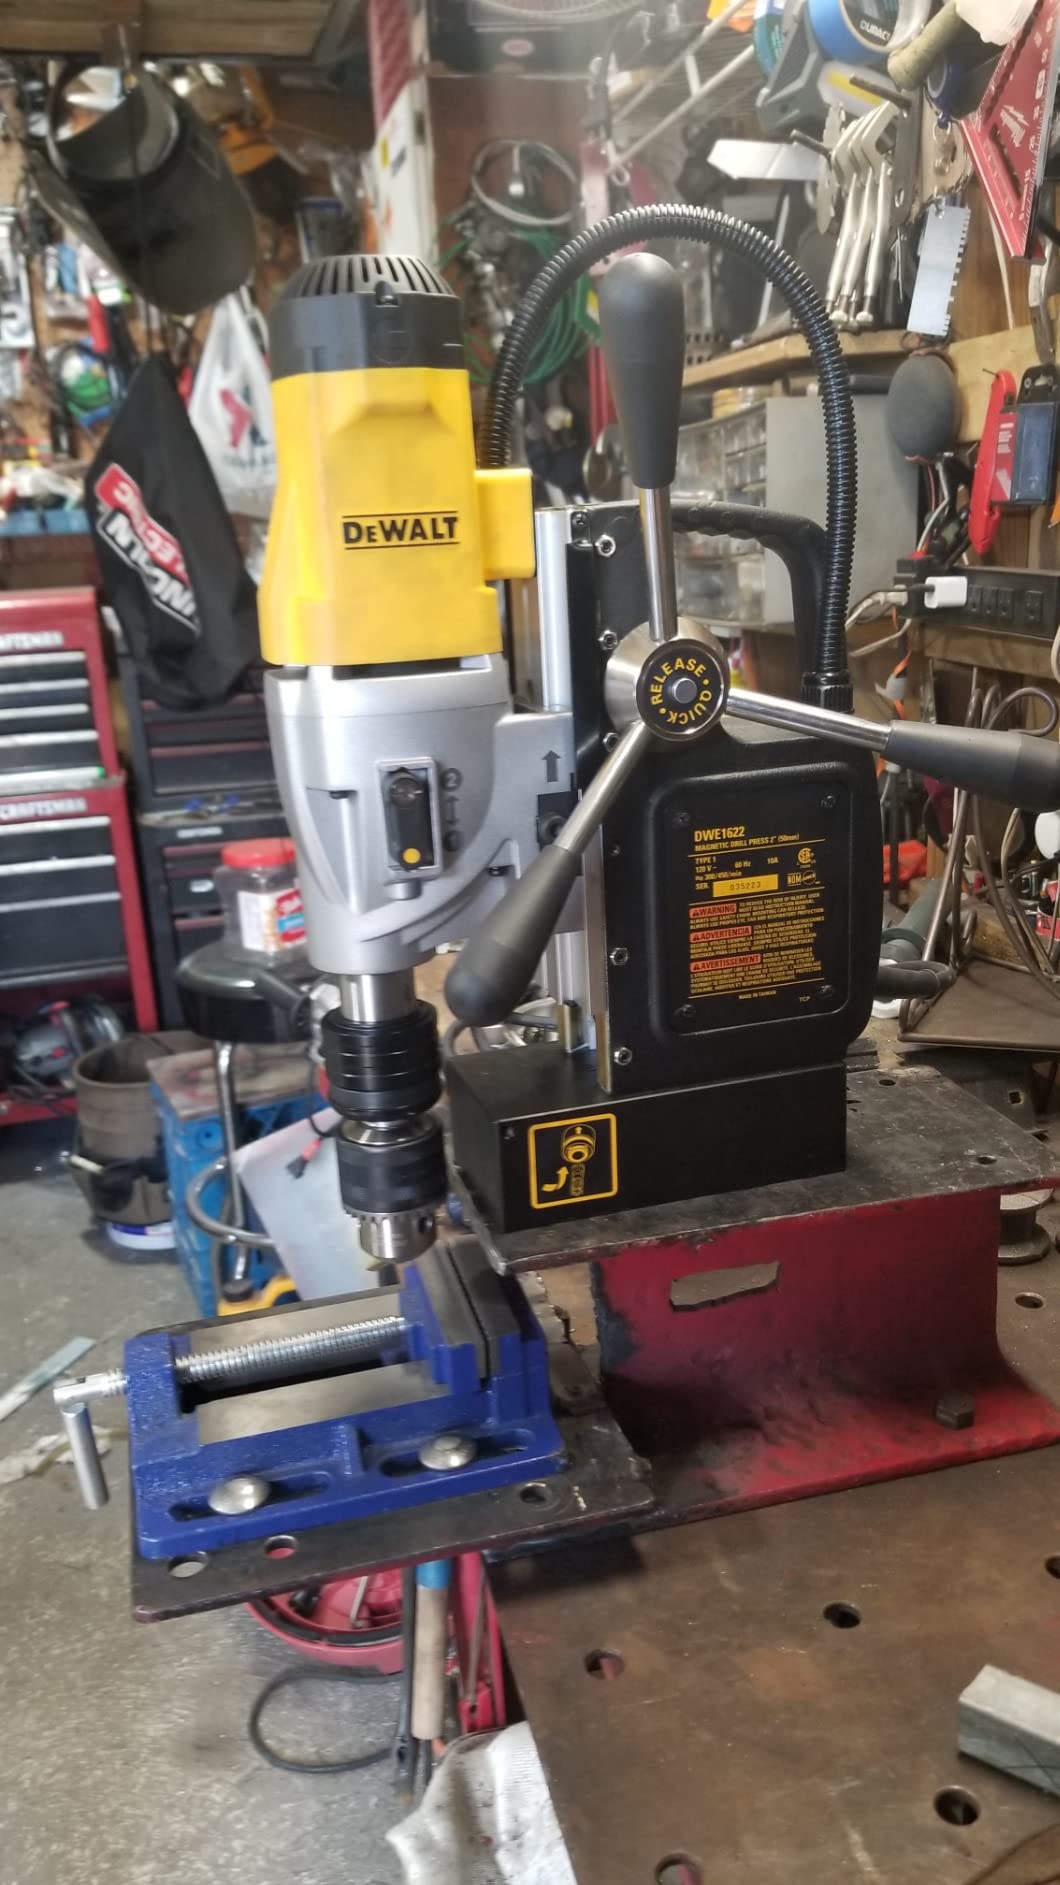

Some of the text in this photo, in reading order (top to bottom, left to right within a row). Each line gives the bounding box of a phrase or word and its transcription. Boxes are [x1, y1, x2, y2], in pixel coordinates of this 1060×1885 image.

[650, 658, 706, 706] RELEASE
[666, 690, 712, 724] QUICK
[694, 826, 745, 842] DWE1622
[694, 841, 729, 852] MAGNETIC
[730, 840, 748, 848] DRILL
[748, 837, 769, 846] PRESS
[696, 857, 712, 865] TYPE
[730, 880, 761, 892] 035223
[700, 904, 734, 916] WARNING
[700, 927, 750, 940] ADVERTENCIA
[700, 956, 759, 970] AVERTISSEMENT
